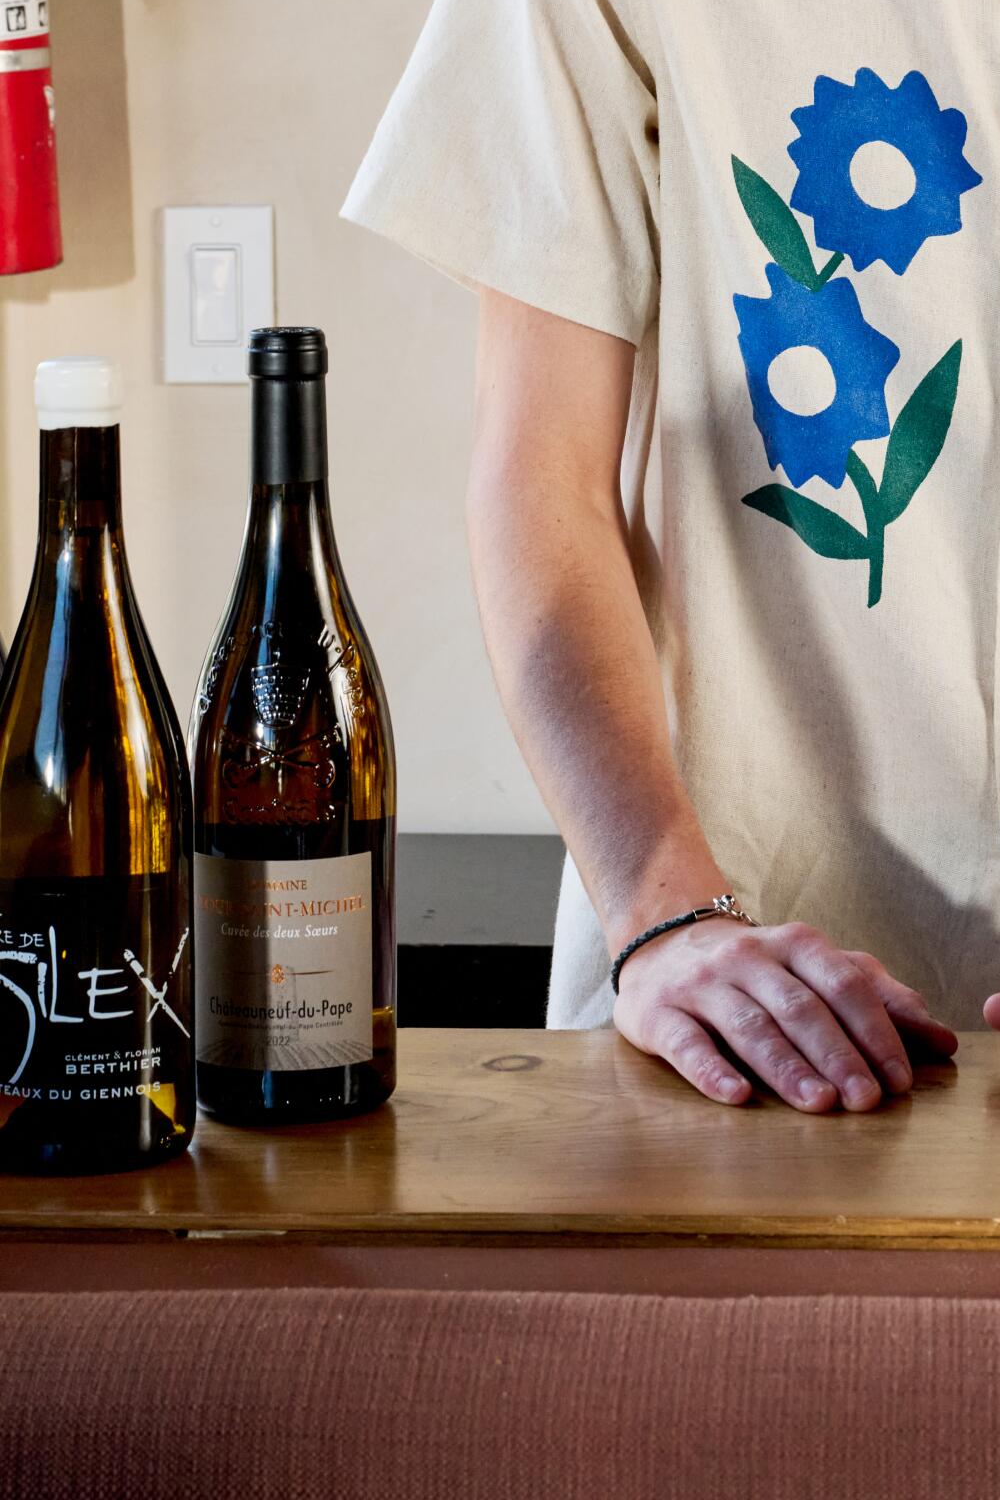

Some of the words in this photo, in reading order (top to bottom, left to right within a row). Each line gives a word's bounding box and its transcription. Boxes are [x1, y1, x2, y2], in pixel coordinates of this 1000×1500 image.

[220, 922, 250, 936] Cuvée
[253, 925, 270, 938] des
[273, 925, 301, 938] deux
[304, 923, 338, 939] Sœurs
[18, 932, 45, 948] DE
[210, 996, 353, 1020] Châteauneuf-du-Pape
[266, 1035, 290, 1046] 2022
[65, 1052, 110, 1062] CLÉMENT
[114, 1050, 121, 1059] &
[125, 1047, 161, 1058] FLORIAN
[66, 1057, 161, 1074] BERTHIER
[49, 1089, 72, 1101] DU
[80, 1081, 161, 1100] GIENNOIS
